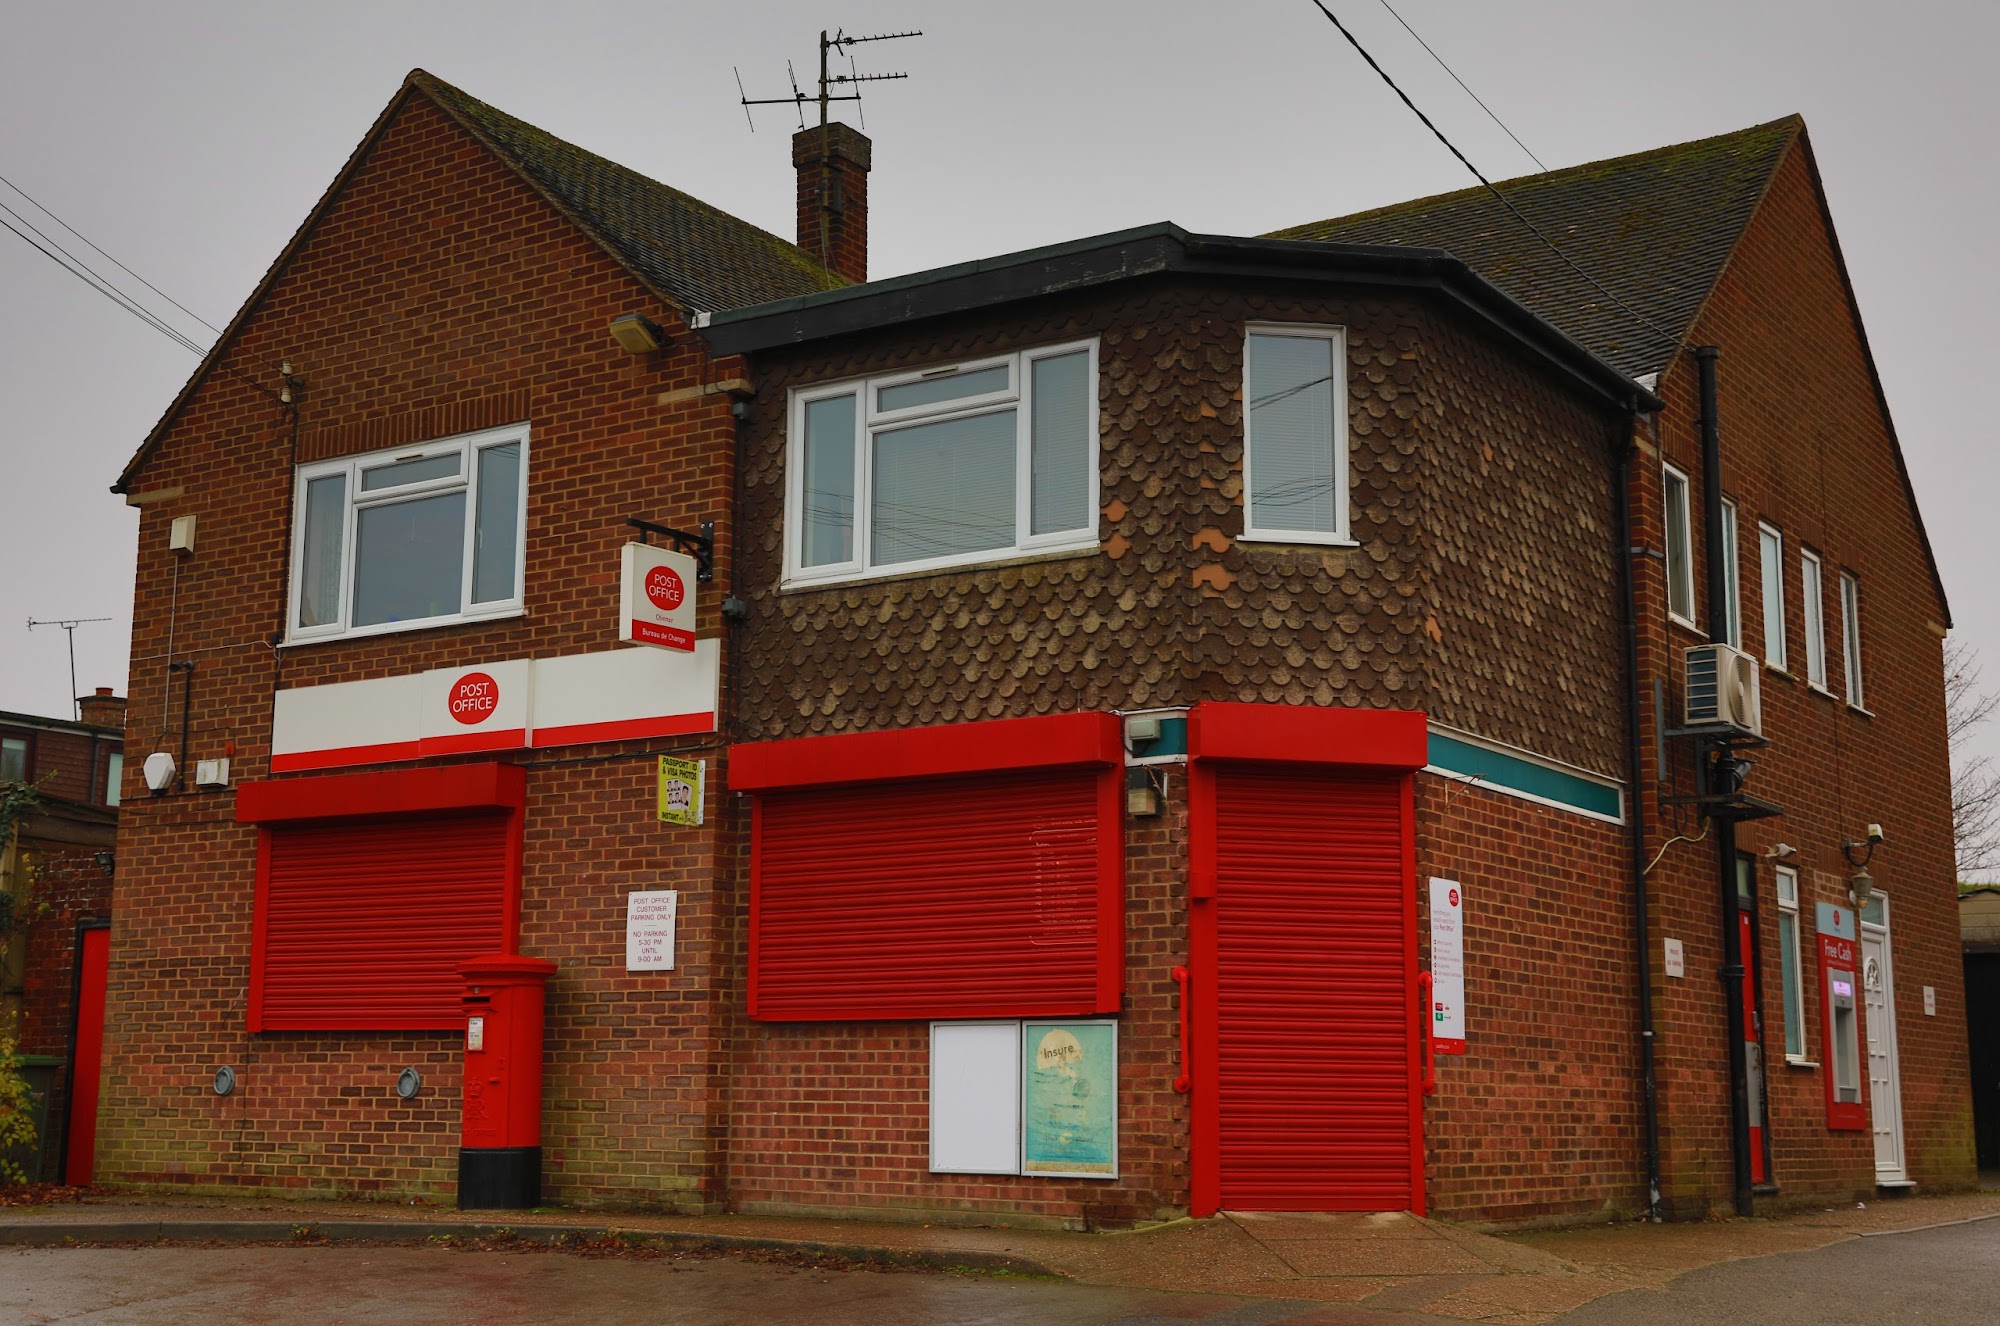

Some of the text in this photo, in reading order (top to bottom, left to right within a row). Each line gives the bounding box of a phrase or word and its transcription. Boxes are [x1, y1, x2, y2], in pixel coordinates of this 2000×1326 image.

[654, 573, 677, 589] POST
[648, 585, 680, 602] OFFICE
[655, 613, 674, 624] Chinnor
[642, 627, 686, 645] Bureau de Change
[460, 682, 490, 698] POST
[452, 696, 493, 713] OFFICE
[662, 757, 689, 769] PASSPORT
[692, 763, 698, 771] ID
[662, 766, 697, 781] & VISA PHOTOS
[661, 811, 679, 822] INSTANT
[633, 897, 648, 905] POST
[636, 905, 667, 913] CUSTOMER
[657, 913, 671, 921] ONLY
[1824, 939, 1852, 961] Free Cash
[1043, 1043, 1075, 1060] Insure
